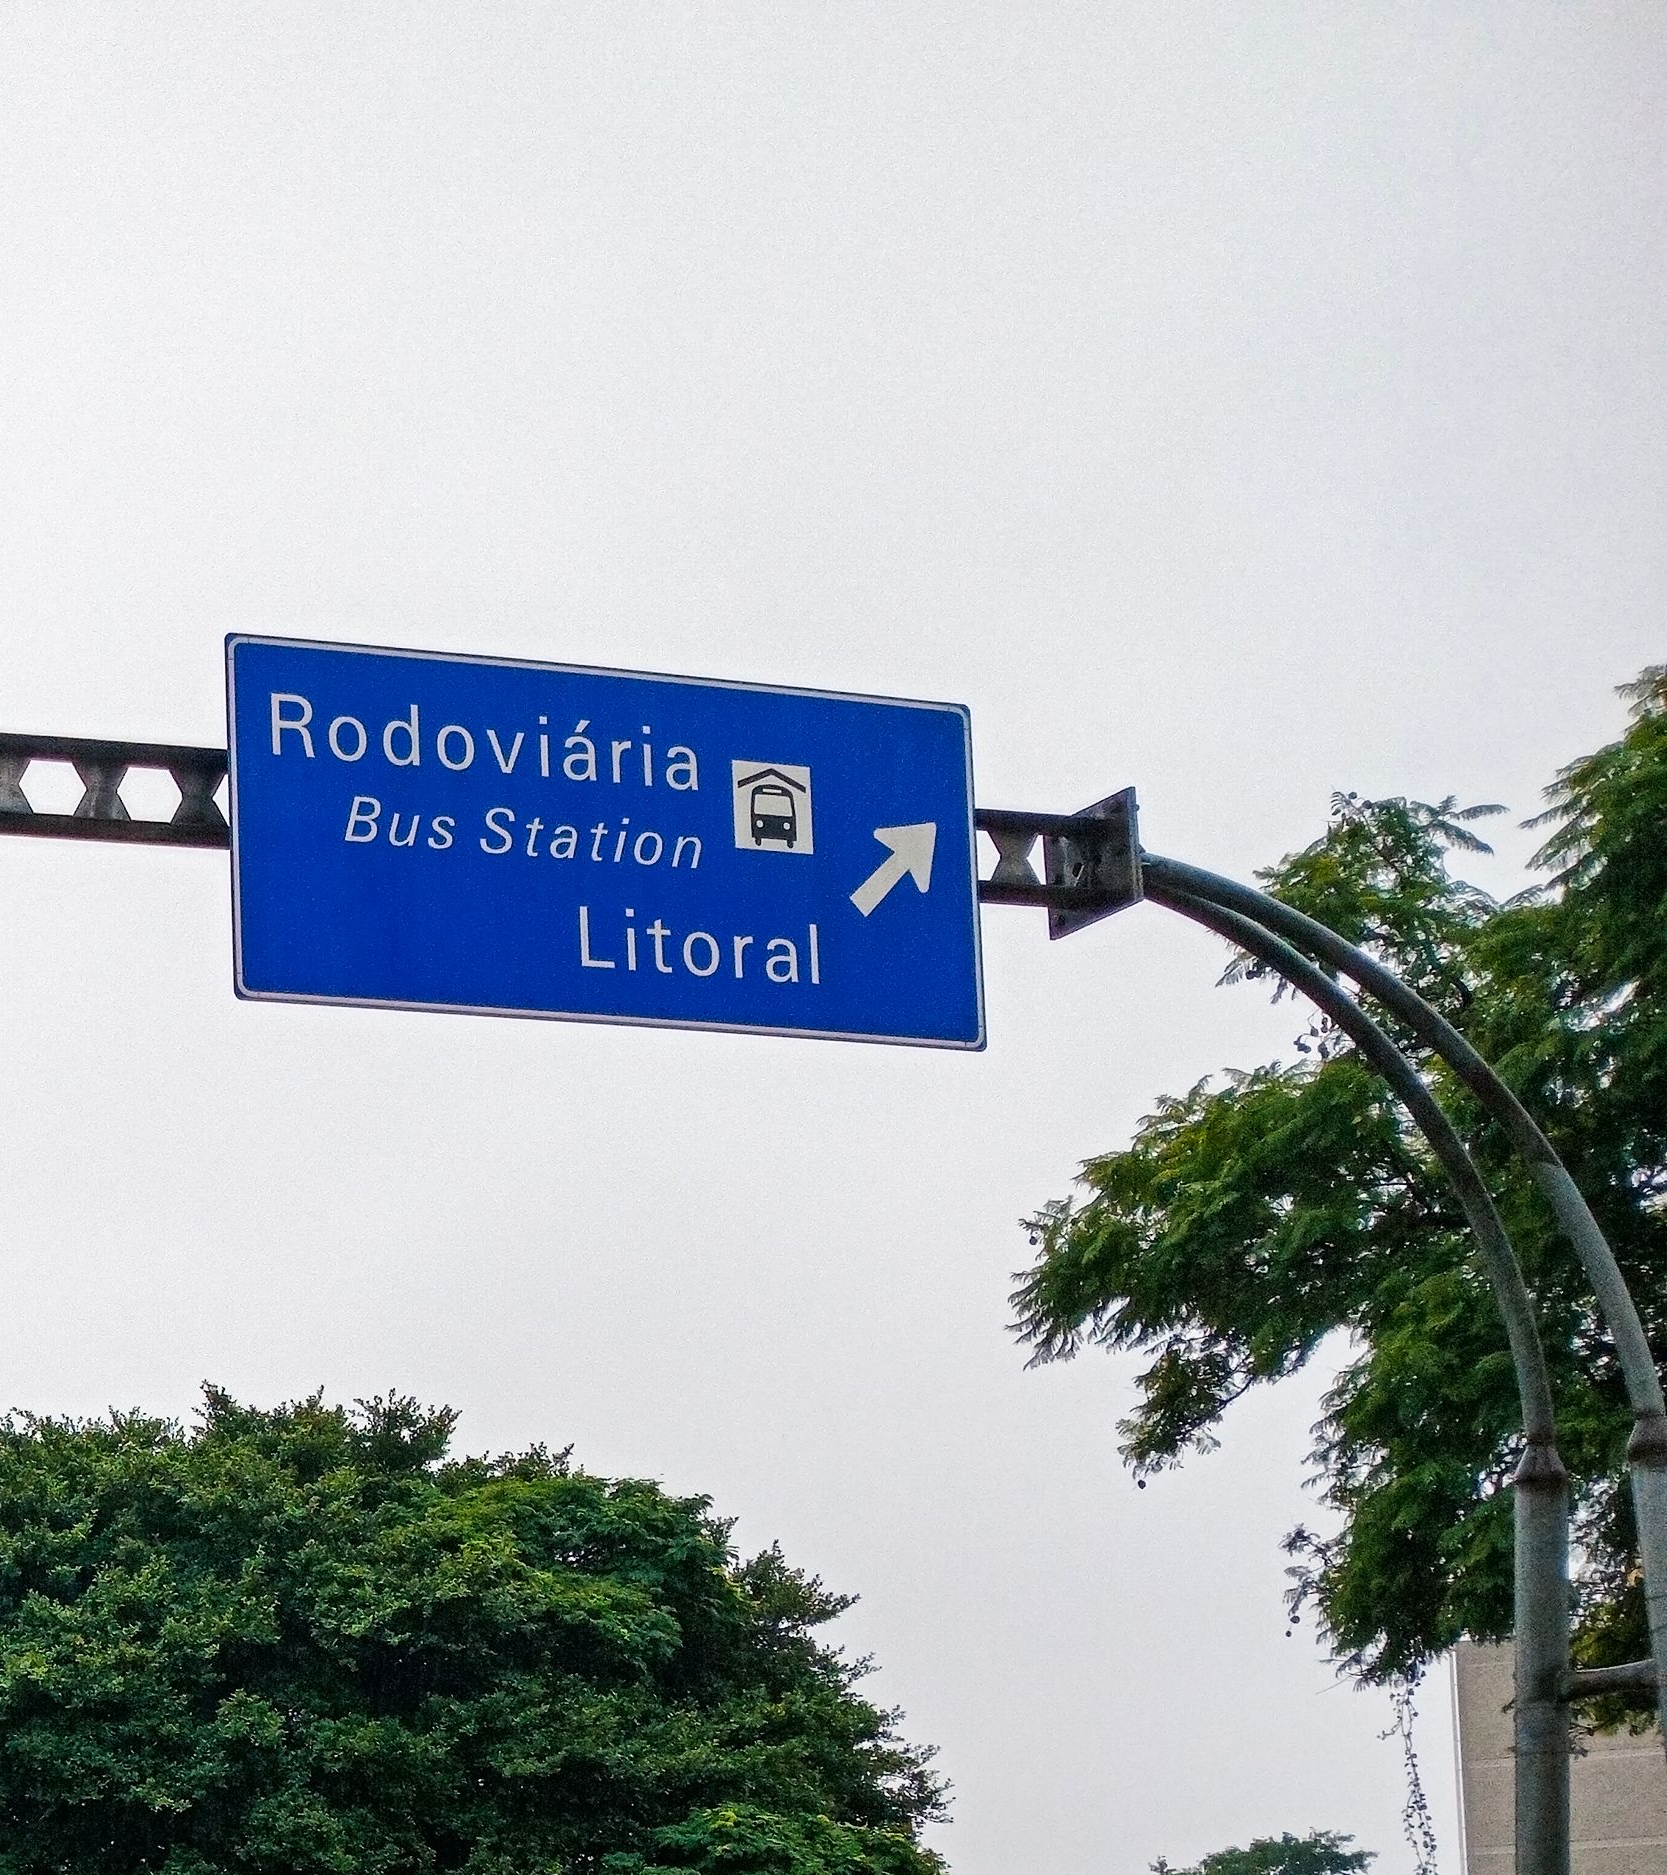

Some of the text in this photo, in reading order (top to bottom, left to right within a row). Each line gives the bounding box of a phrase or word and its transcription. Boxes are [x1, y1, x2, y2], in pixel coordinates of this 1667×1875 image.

[270, 691, 700, 792] Rodoviária
[344, 796, 704, 870] Bus Station
[578, 905, 821, 985] Litoral
